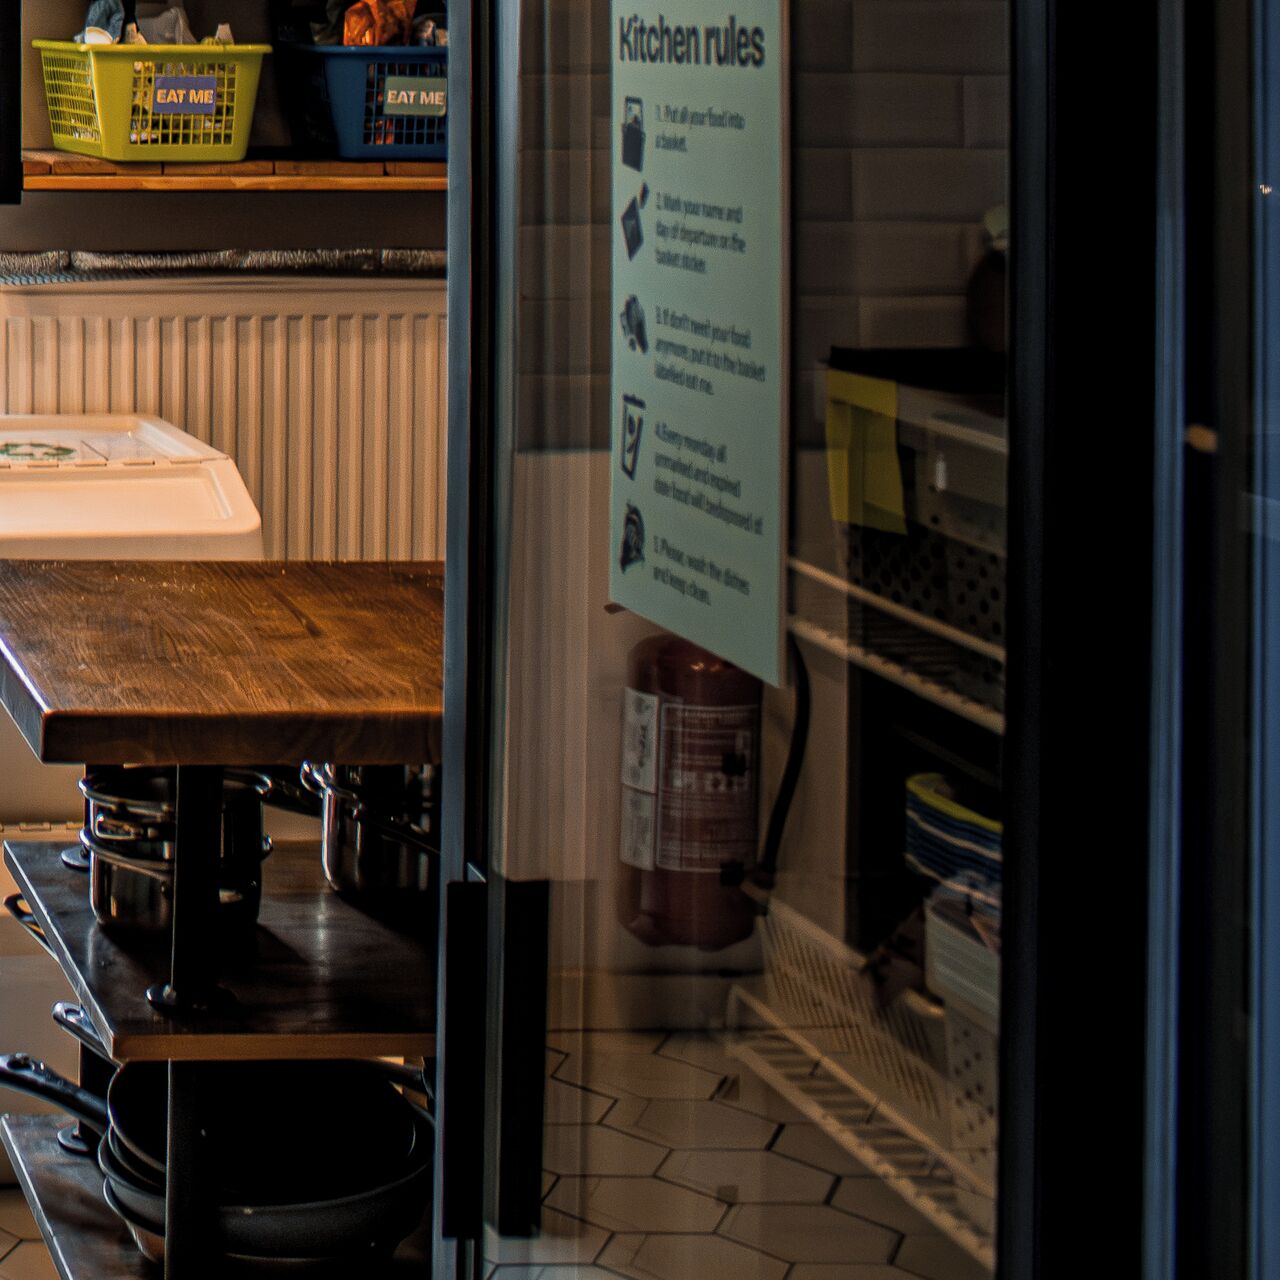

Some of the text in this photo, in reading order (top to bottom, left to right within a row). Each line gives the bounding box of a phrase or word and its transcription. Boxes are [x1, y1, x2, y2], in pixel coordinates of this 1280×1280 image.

[619, 13, 766, 69] Kitchen rules
[156, 89, 214, 104] EAT ME
[387, 89, 445, 105] EAT ME
